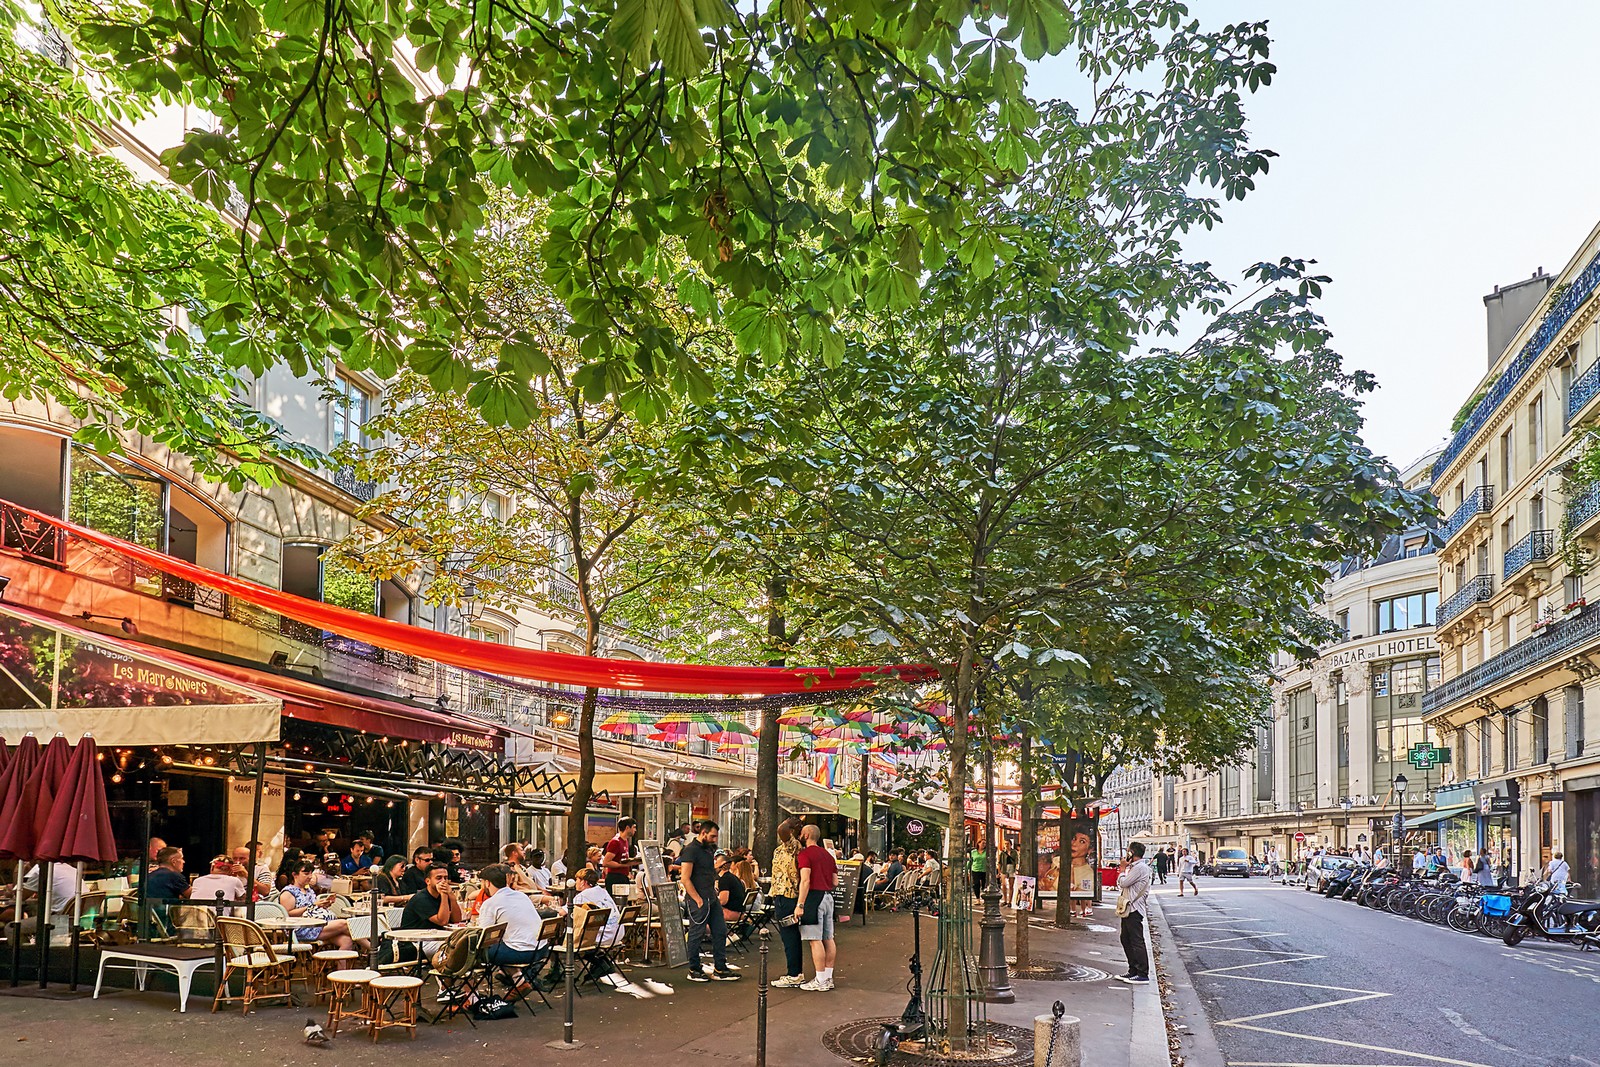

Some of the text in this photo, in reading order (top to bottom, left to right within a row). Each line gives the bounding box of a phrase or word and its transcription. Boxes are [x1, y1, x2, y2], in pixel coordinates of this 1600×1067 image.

[1333, 648, 1366, 667] BAZAR
[1367, 651, 1376, 659] DE
[113, 663, 134, 680] Les
[1350, 794, 1380, 806] BHV
[1393, 792, 1432, 804] MAR
